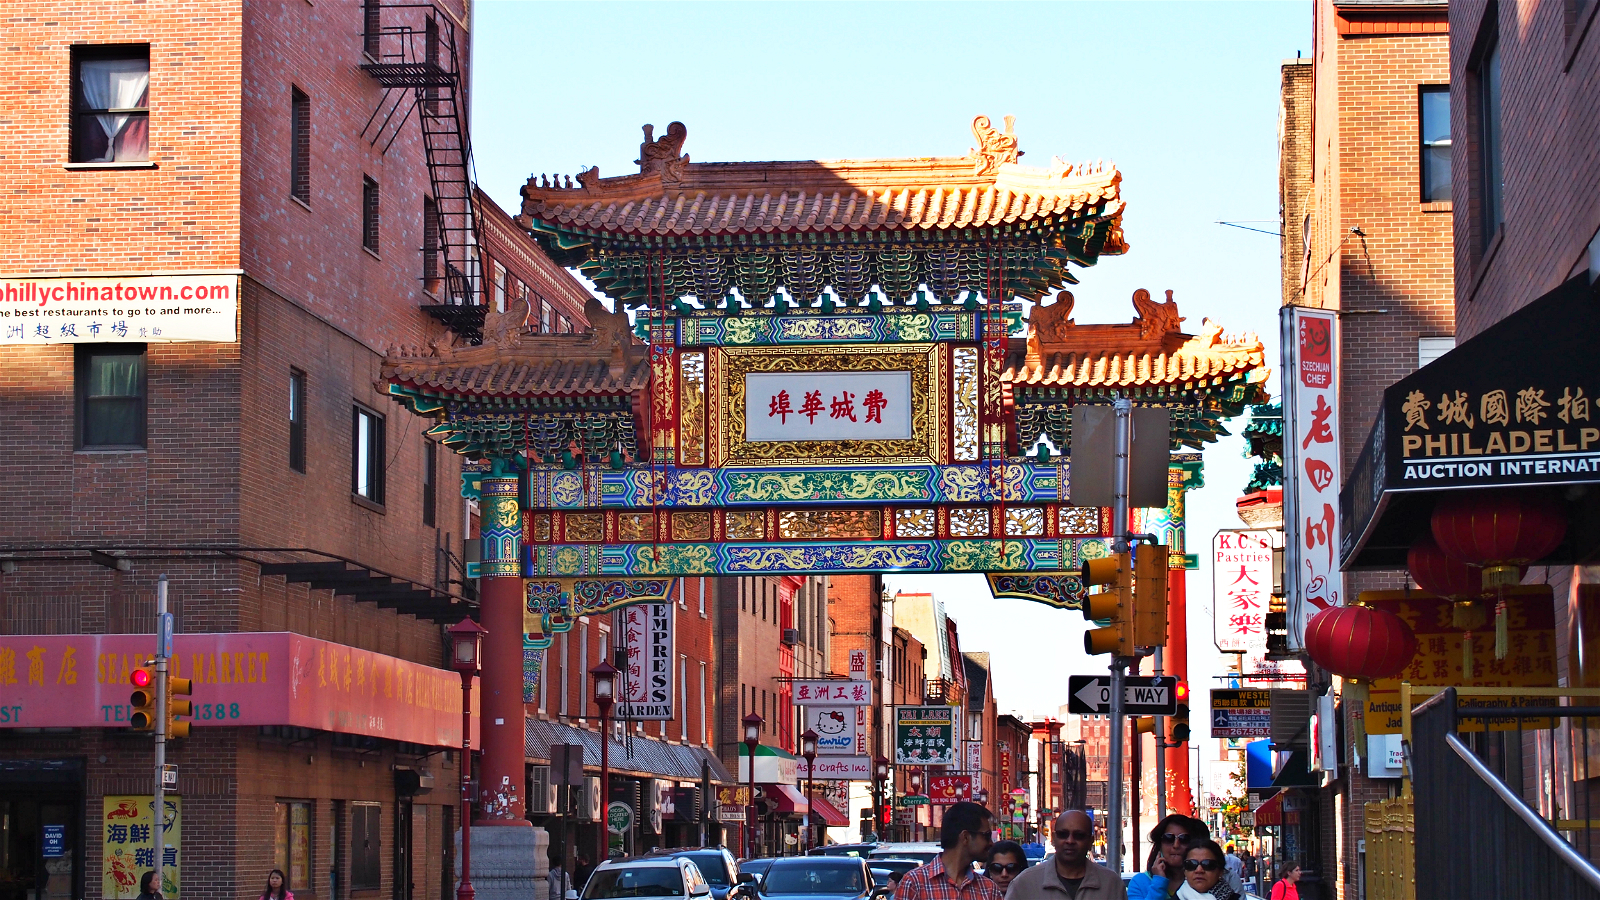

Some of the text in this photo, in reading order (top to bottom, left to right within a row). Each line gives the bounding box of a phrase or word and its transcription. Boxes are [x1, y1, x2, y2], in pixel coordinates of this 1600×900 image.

[14, 308, 39, 316] best
[44, 308, 108, 316] restaurants
[112, 308, 123, 316] to
[128, 308, 140, 318] go
[146, 306, 156, 315] to
[160, 306, 180, 314] and
[1302, 360, 1330, 372] SZECHUAN
[1306, 373, 1326, 384] CHEF
[1402, 386, 1600, 432] 費城國際拍
[1402, 428, 1600, 457] PHILADELP
[1404, 458, 1600, 479] AUCTION INTERNAT
[1303, 394, 1336, 574] 老四川
[1219, 534, 1268, 549] K.C.'s
[1216, 552, 1270, 562] Pastries
[1227, 564, 1262, 635] 大家樂
[652, 604, 668, 702] EMPRESS
[192, 652, 269, 684] MARKET
[796, 684, 867, 701] 亞洲工藝
[1100, 688, 1164, 703] OE WAY
[1458, 697, 1508, 708] Calligraphy
[1518, 695, 1556, 708] Painting
[0, 706, 22, 722] ST
[618, 705, 670, 716] GARDEN
[900, 710, 950, 720] TAI LAKE
[796, 764, 816, 772] Asa
[820, 762, 849, 774] Crafts
[852, 764, 868, 772] Inc.
[1258, 812, 1274, 825] SIU
[106, 824, 150, 844] 海鮮
